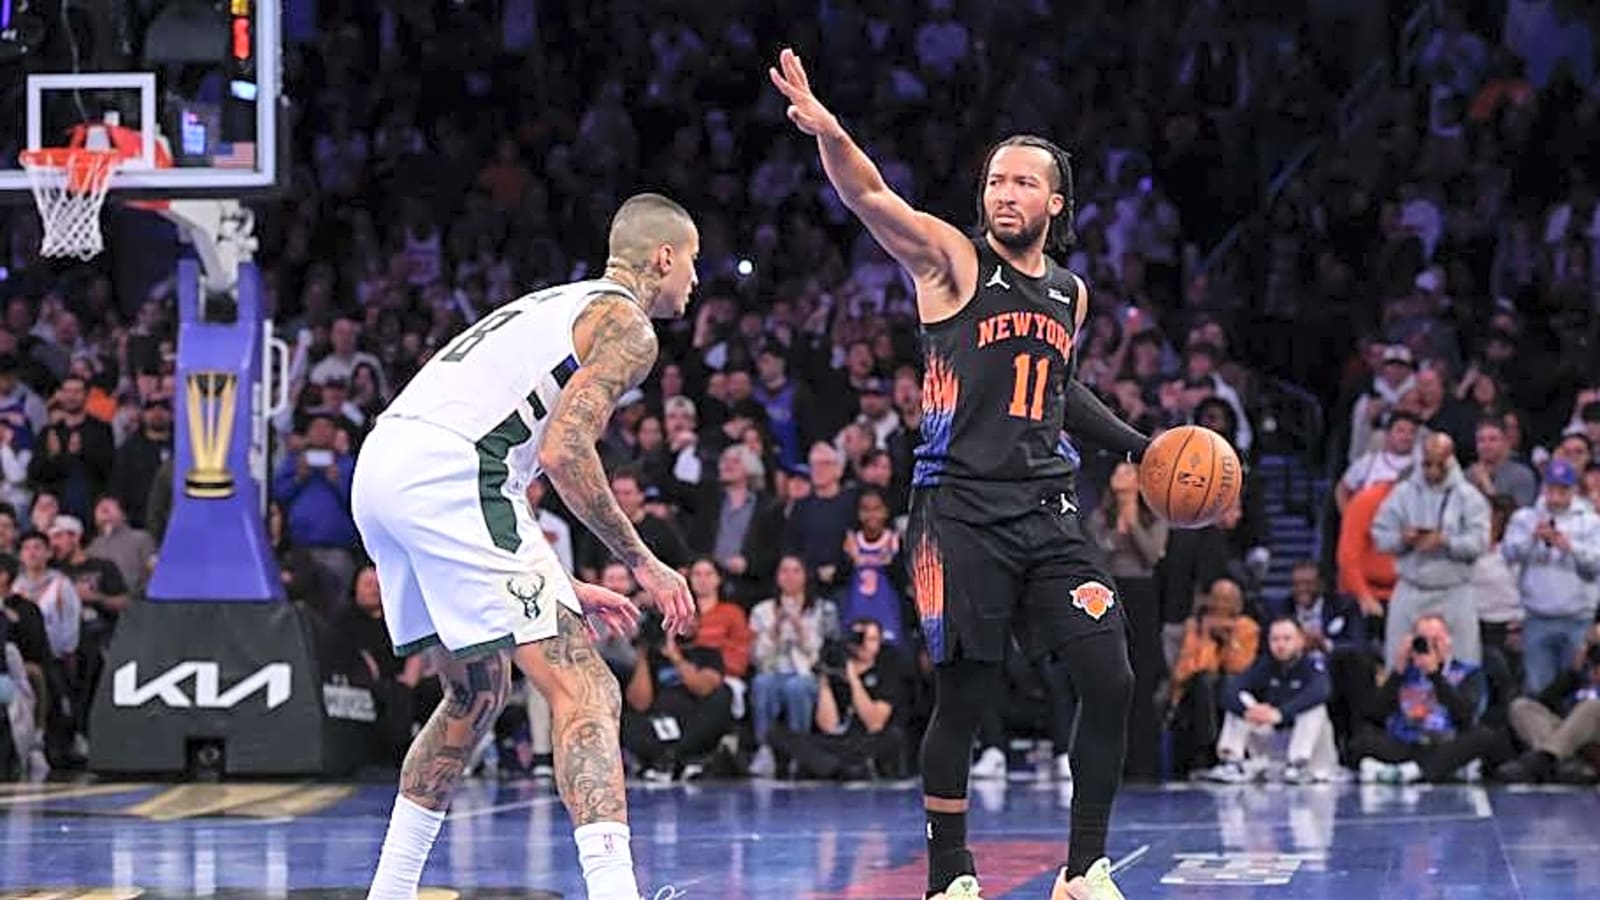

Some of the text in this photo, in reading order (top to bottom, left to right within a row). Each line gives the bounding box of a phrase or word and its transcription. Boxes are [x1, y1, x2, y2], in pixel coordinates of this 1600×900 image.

[440, 310, 523, 362] 8
[1008, 353, 1050, 422] 11
[859, 569, 877, 595] 3
[113, 660, 292, 709] KIA
